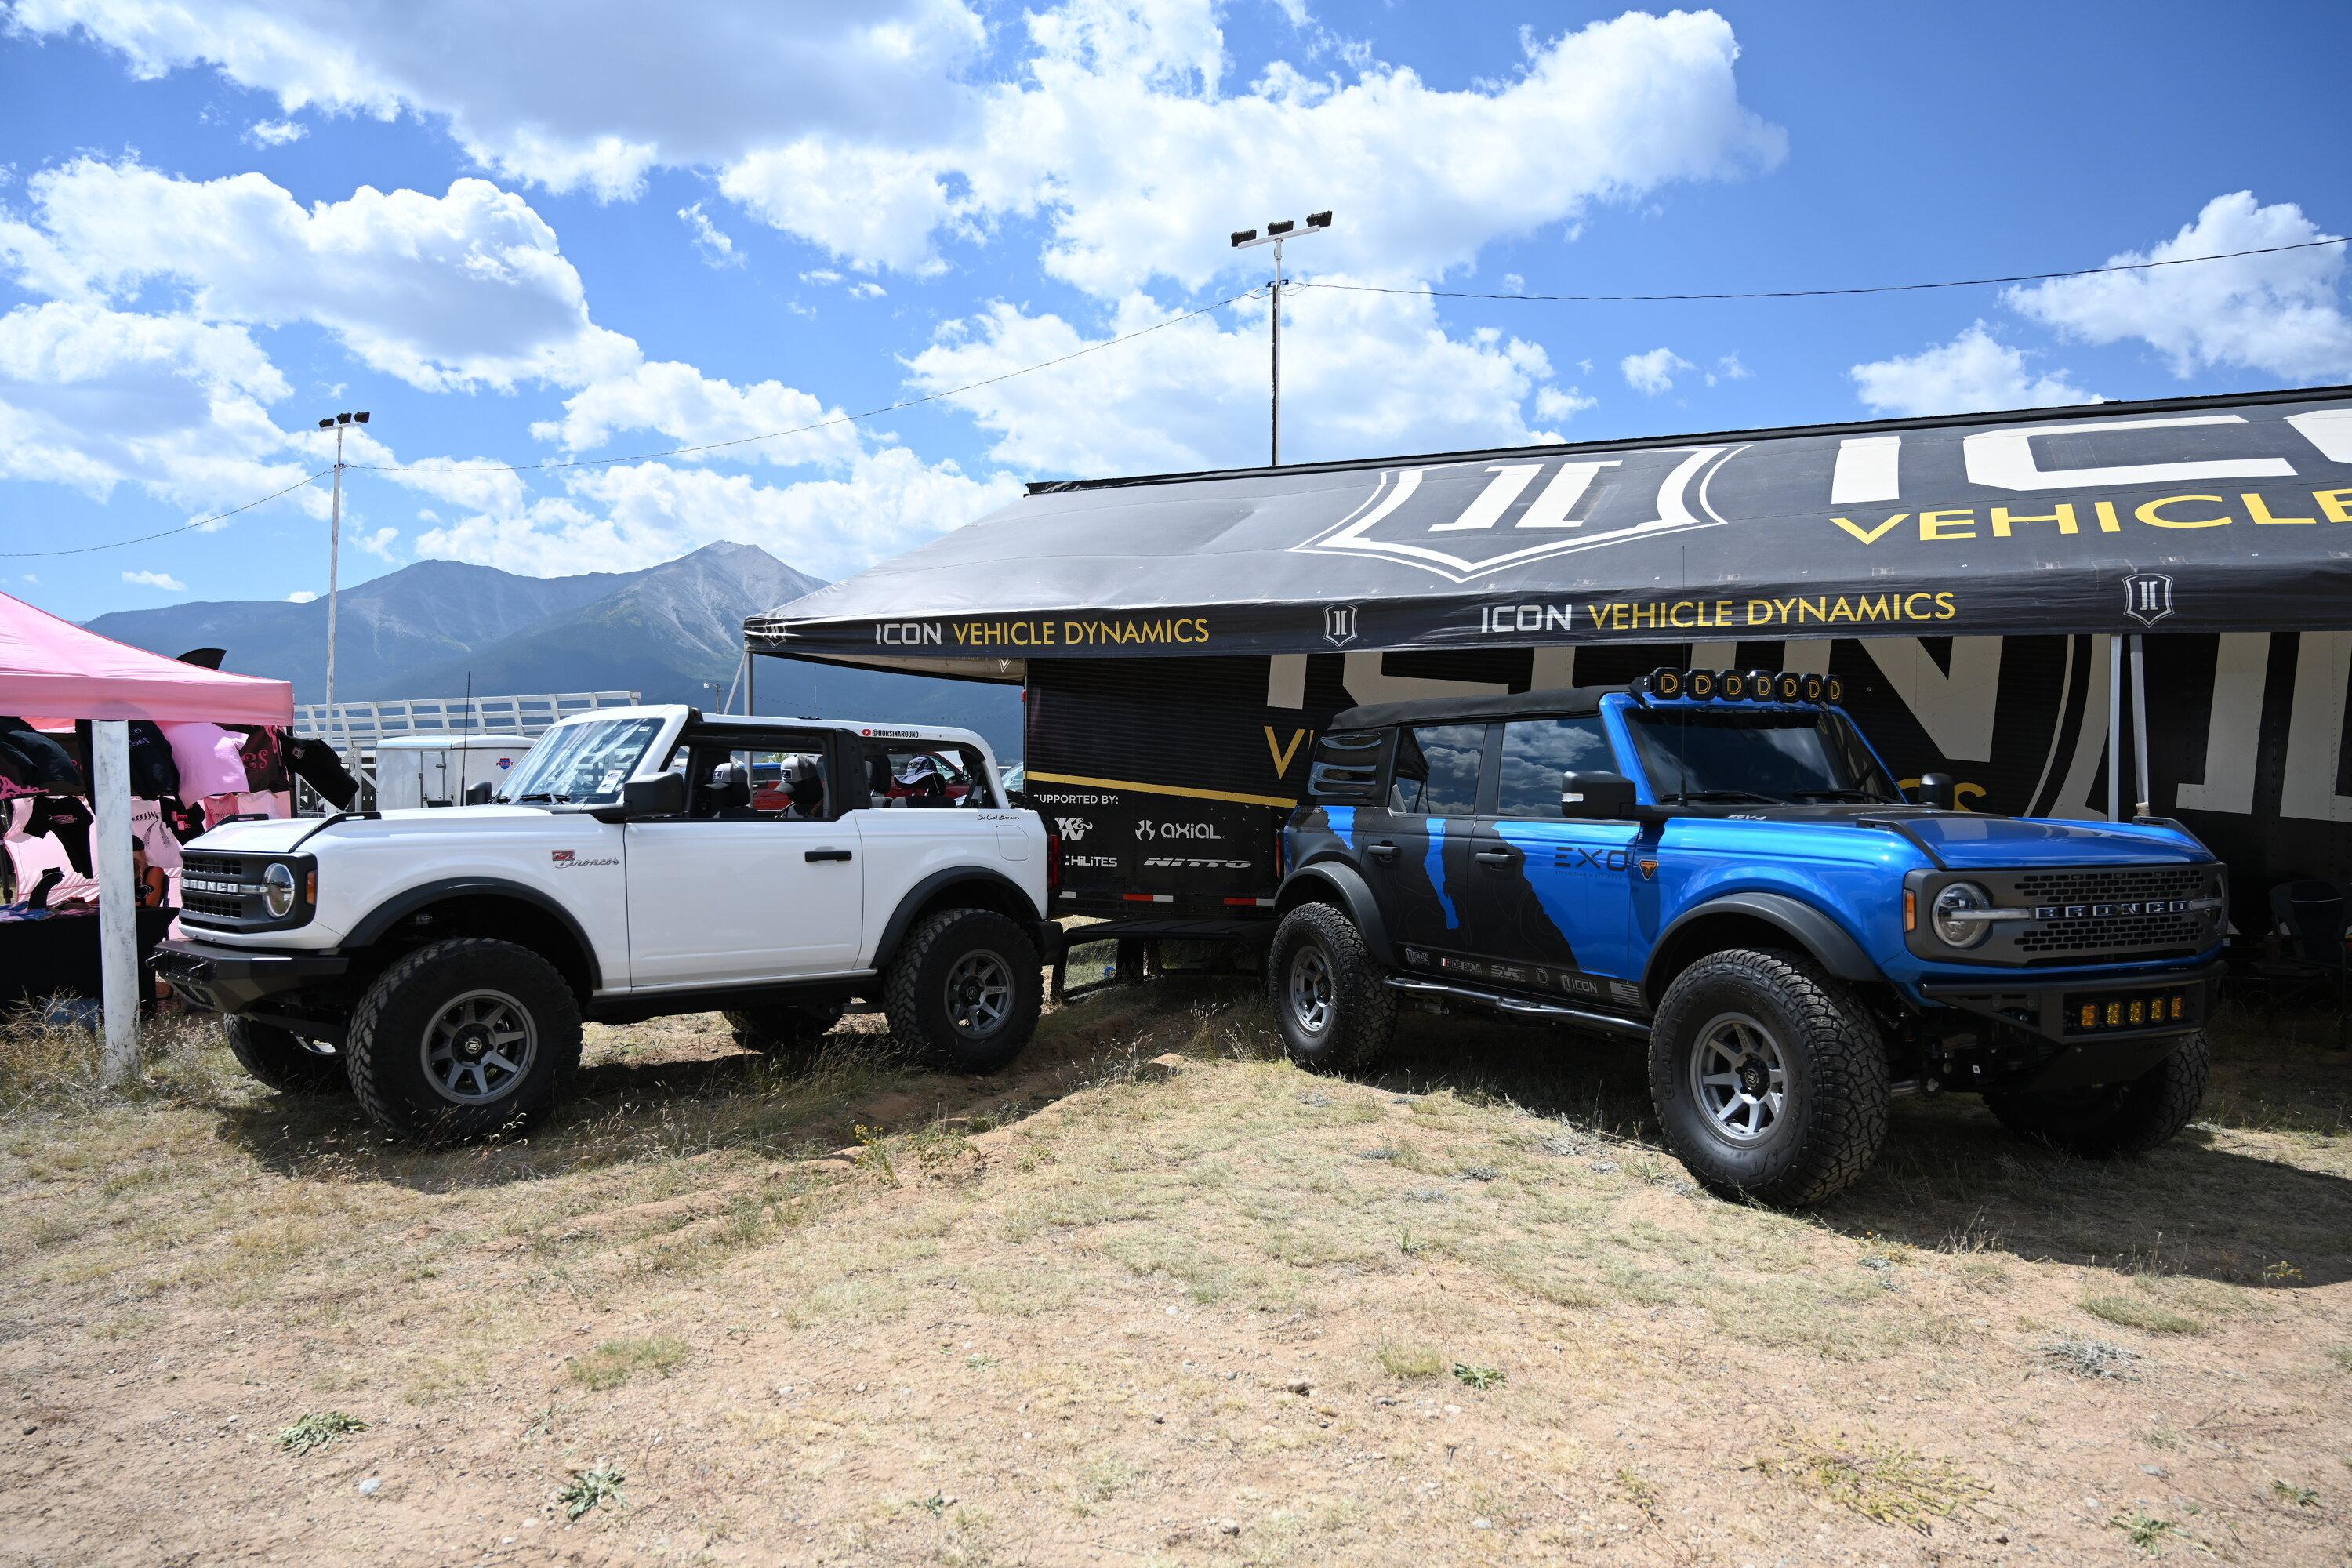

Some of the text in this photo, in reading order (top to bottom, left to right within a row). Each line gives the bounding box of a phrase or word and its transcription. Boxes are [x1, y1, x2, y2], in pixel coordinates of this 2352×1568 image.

[1482, 592, 1956, 633] ICON VEHICLE DYNAMICS
[875, 618, 1210, 646] ICON VEHICLE DYNAMICS
[1033, 794, 1119, 804] UPPORTED BY:
[1144, 858, 1252, 868] NITTO
[1555, 847, 1628, 871] EXO
[183, 879, 238, 893] BRONCO
[2036, 901, 2187, 919] BRONCO
[1571, 978, 1598, 994] ICON
